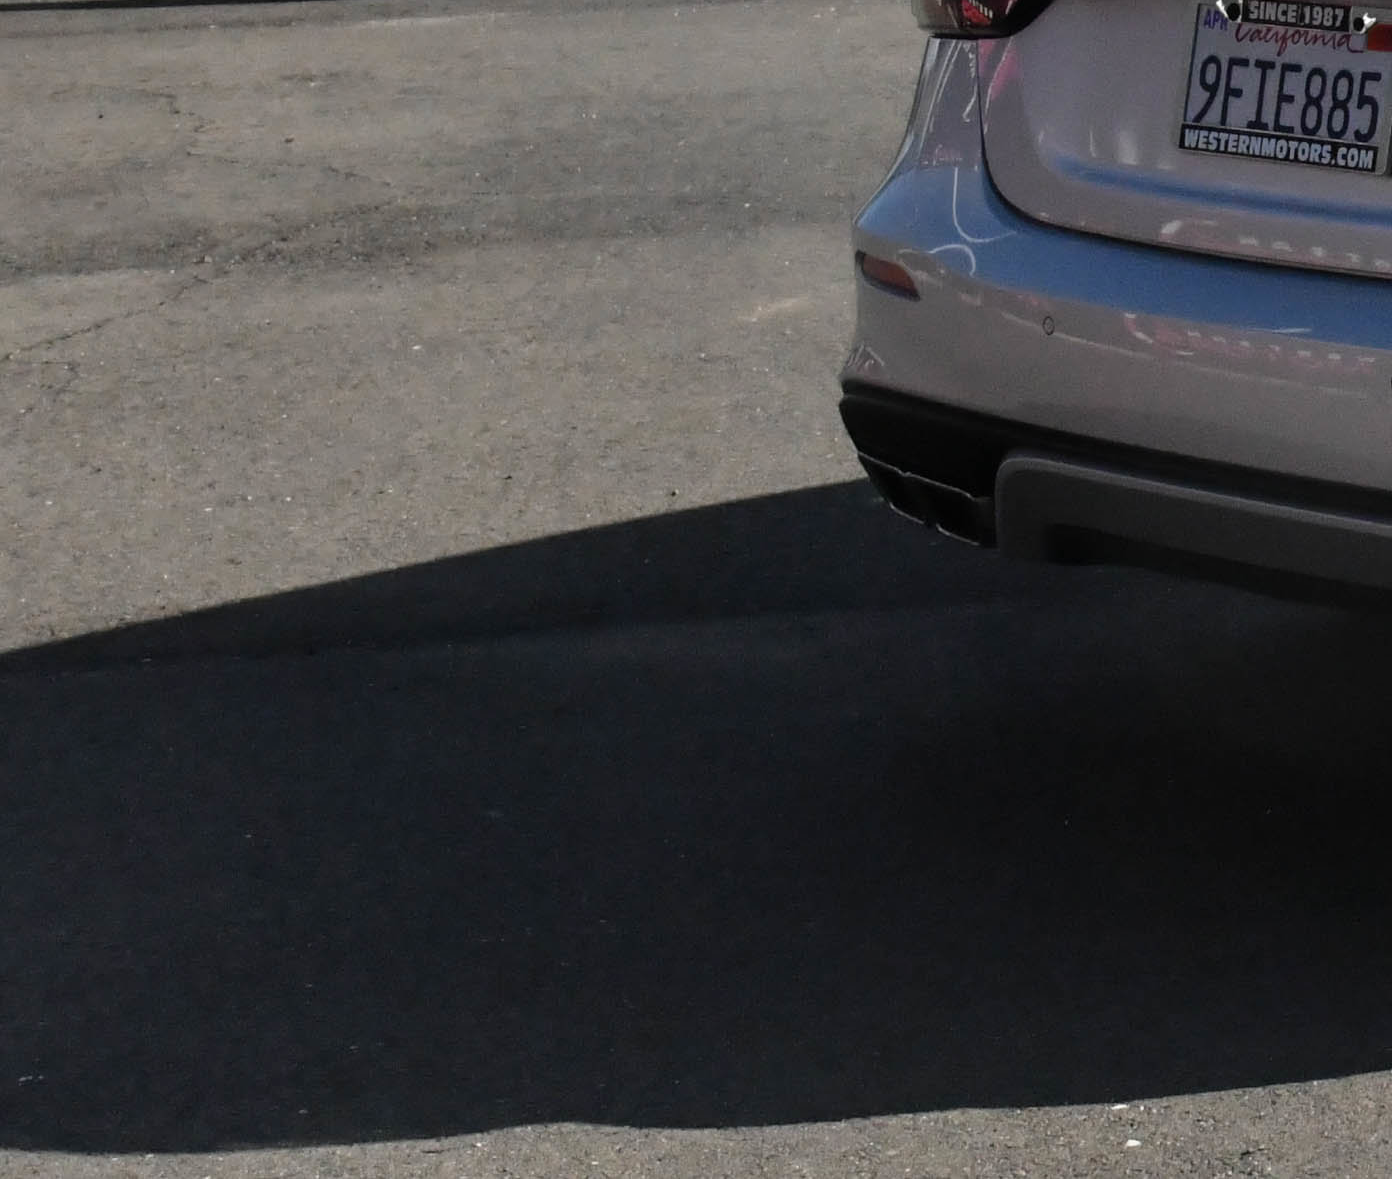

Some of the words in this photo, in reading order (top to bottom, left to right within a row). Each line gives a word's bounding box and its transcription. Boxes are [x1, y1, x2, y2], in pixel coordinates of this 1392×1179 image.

[1249, 0, 1298, 23] SINCE
[1303, 4, 1345, 27] 1987
[1234, 21, 1364, 56] California
[1191, 54, 1382, 143] 9FIE885
[1184, 129, 1375, 170] WESTERNMOTORS.COM
